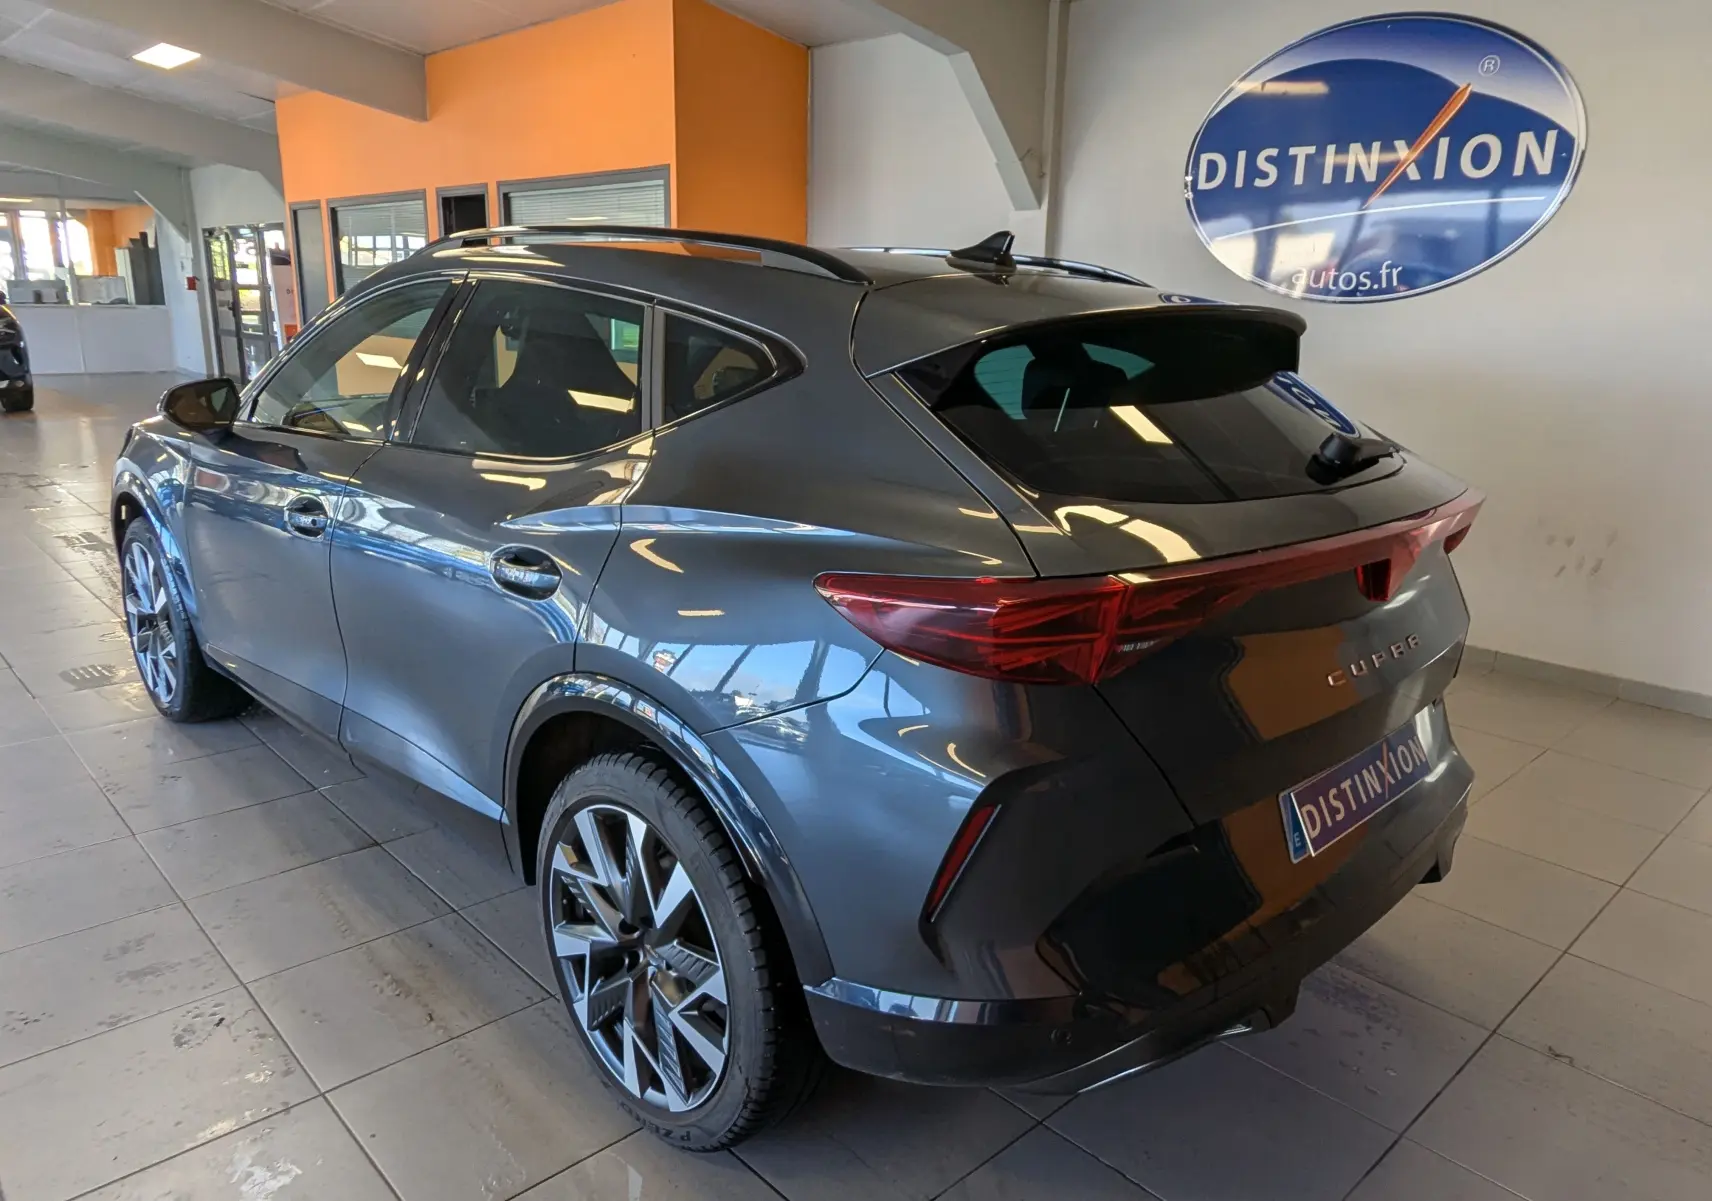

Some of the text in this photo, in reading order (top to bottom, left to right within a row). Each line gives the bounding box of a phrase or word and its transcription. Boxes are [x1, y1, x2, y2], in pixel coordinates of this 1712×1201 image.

[1197, 130, 1558, 191] DISTINXION
[1291, 260, 1403, 292] autos.fr
[1300, 735, 1427, 839] DISTINXION
